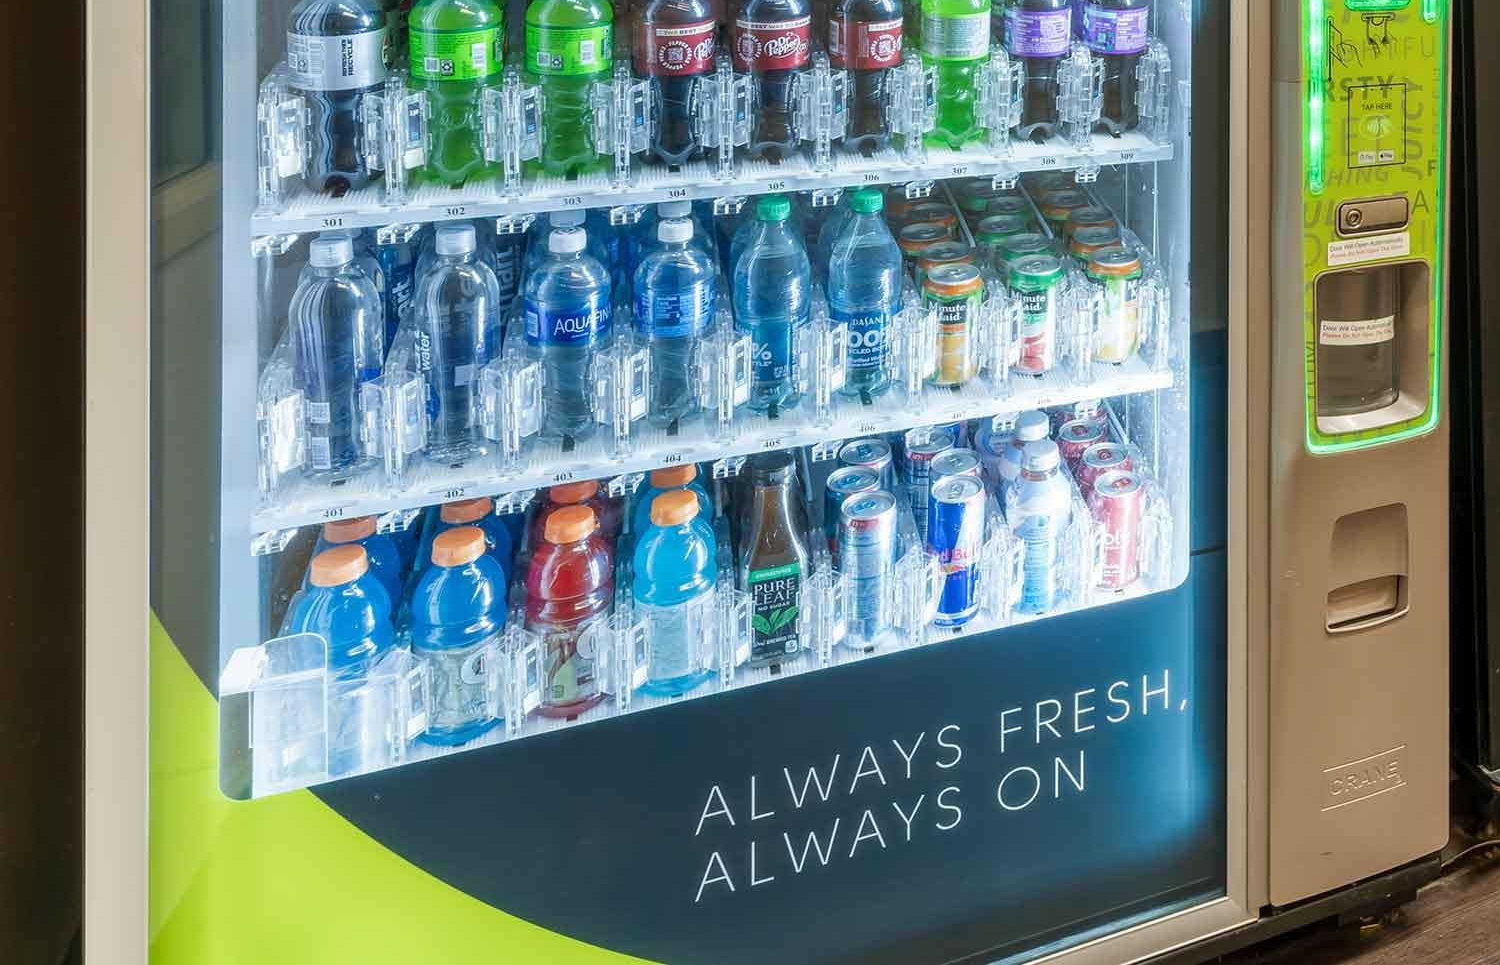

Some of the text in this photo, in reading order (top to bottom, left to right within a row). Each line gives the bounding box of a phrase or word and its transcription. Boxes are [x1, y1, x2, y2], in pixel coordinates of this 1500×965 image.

[1376, 102, 1393, 110] HERE
[1119, 152, 1134, 161] 309
[1041, 157, 1056, 167] 308
[951, 166, 968, 176] 307
[863, 173, 880, 183] 306
[767, 182, 785, 192] 305
[668, 189, 686, 199] 304
[563, 196, 582, 206] 303
[445, 207, 465, 217] 302
[322, 218, 343, 229] 301
[553, 308, 612, 337] AQUAFIN
[852, 316, 882, 327] DASAN
[421, 331, 433, 372] water
[764, 439, 781, 449] 405
[664, 454, 682, 464] 404
[553, 472, 573, 482] 403
[444, 488, 465, 499] 402
[323, 508, 344, 518] 401
[754, 577, 796, 596] PURE
[755, 587, 795, 607] LEAF
[770, 601, 791, 609] SUGAR
[695, 668, 1188, 836] ALWAYS FRESH,
[1329, 760, 1402, 796] CRANE
[695, 750, 1086, 903] ALWAYS ON
